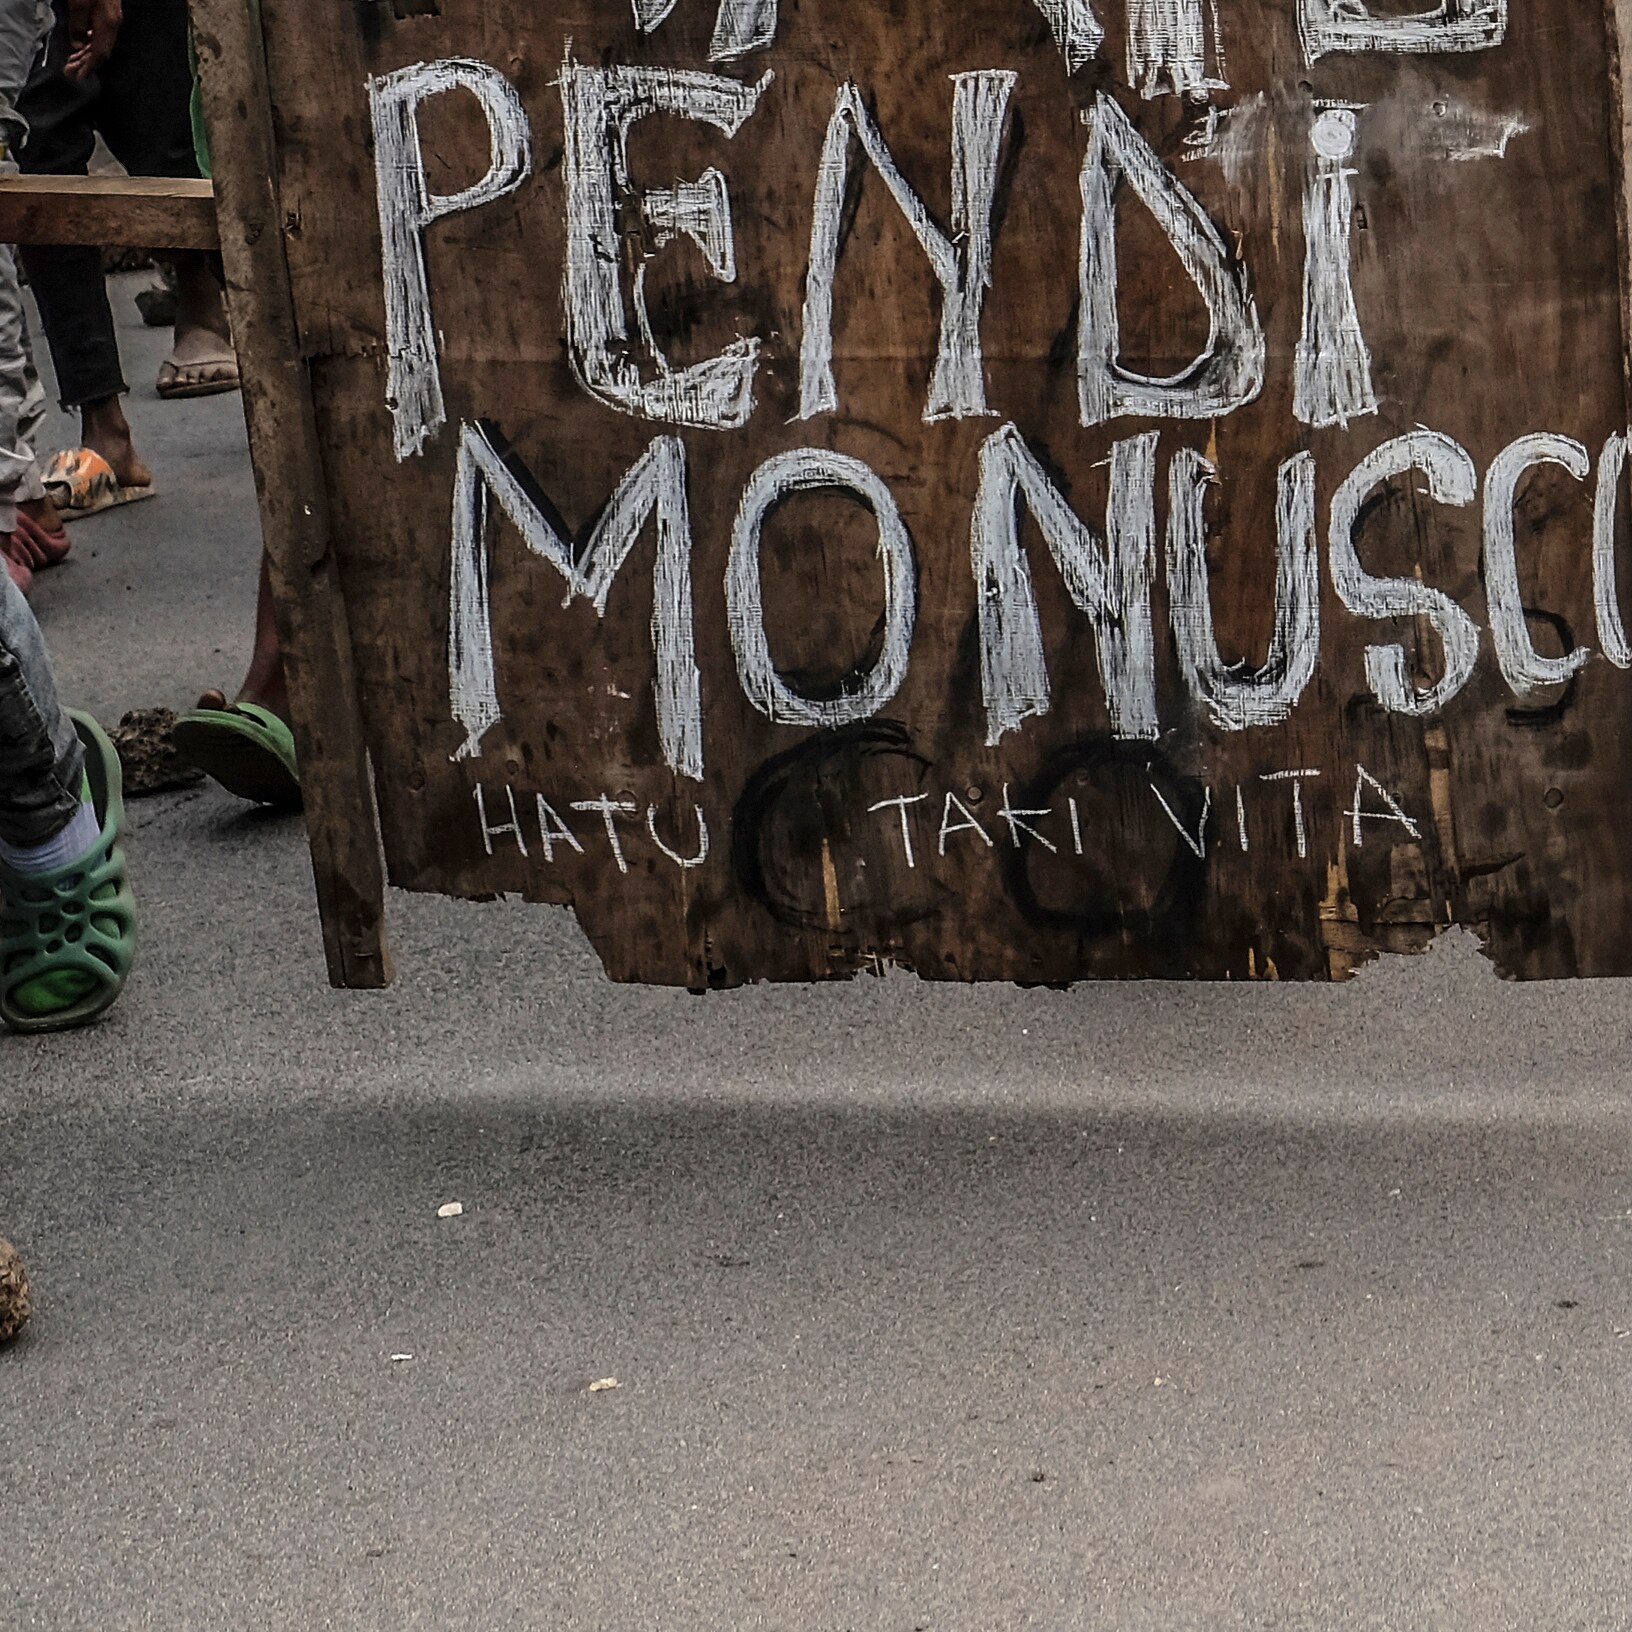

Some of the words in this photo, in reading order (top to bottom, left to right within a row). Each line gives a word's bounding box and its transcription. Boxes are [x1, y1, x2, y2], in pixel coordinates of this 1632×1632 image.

[473, 784, 709, 875] HATU
[867, 781, 1084, 868] TAKI
[1148, 764, 1422, 862] VITA
